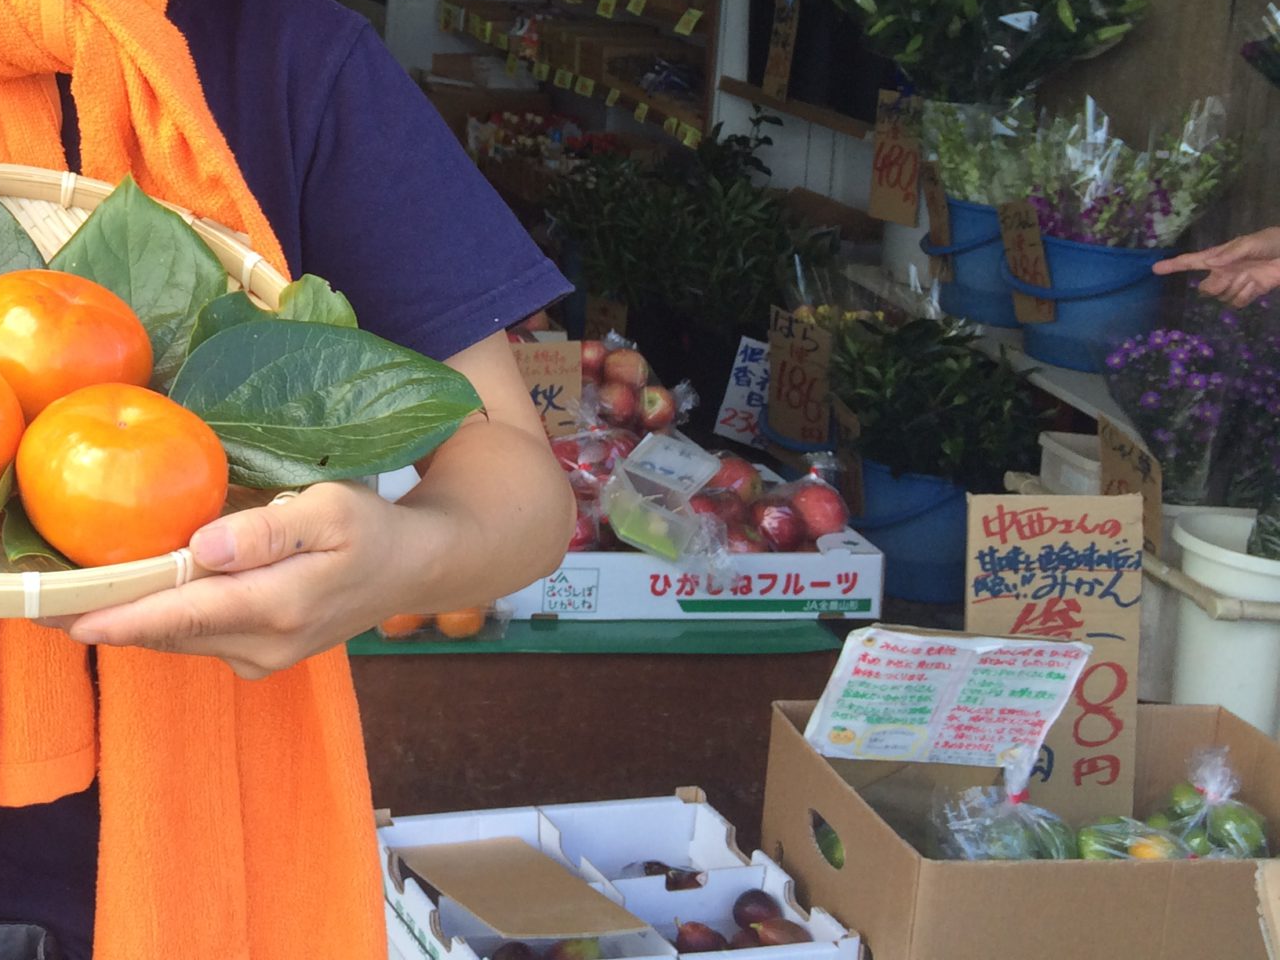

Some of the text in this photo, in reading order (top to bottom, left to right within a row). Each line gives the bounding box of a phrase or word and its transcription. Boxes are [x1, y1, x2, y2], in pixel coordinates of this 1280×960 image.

[982, 503, 1122, 545] 中西さんの
[649, 571, 859, 597] ひがしねフルーツ
[1073, 754, 1121, 786] 円
